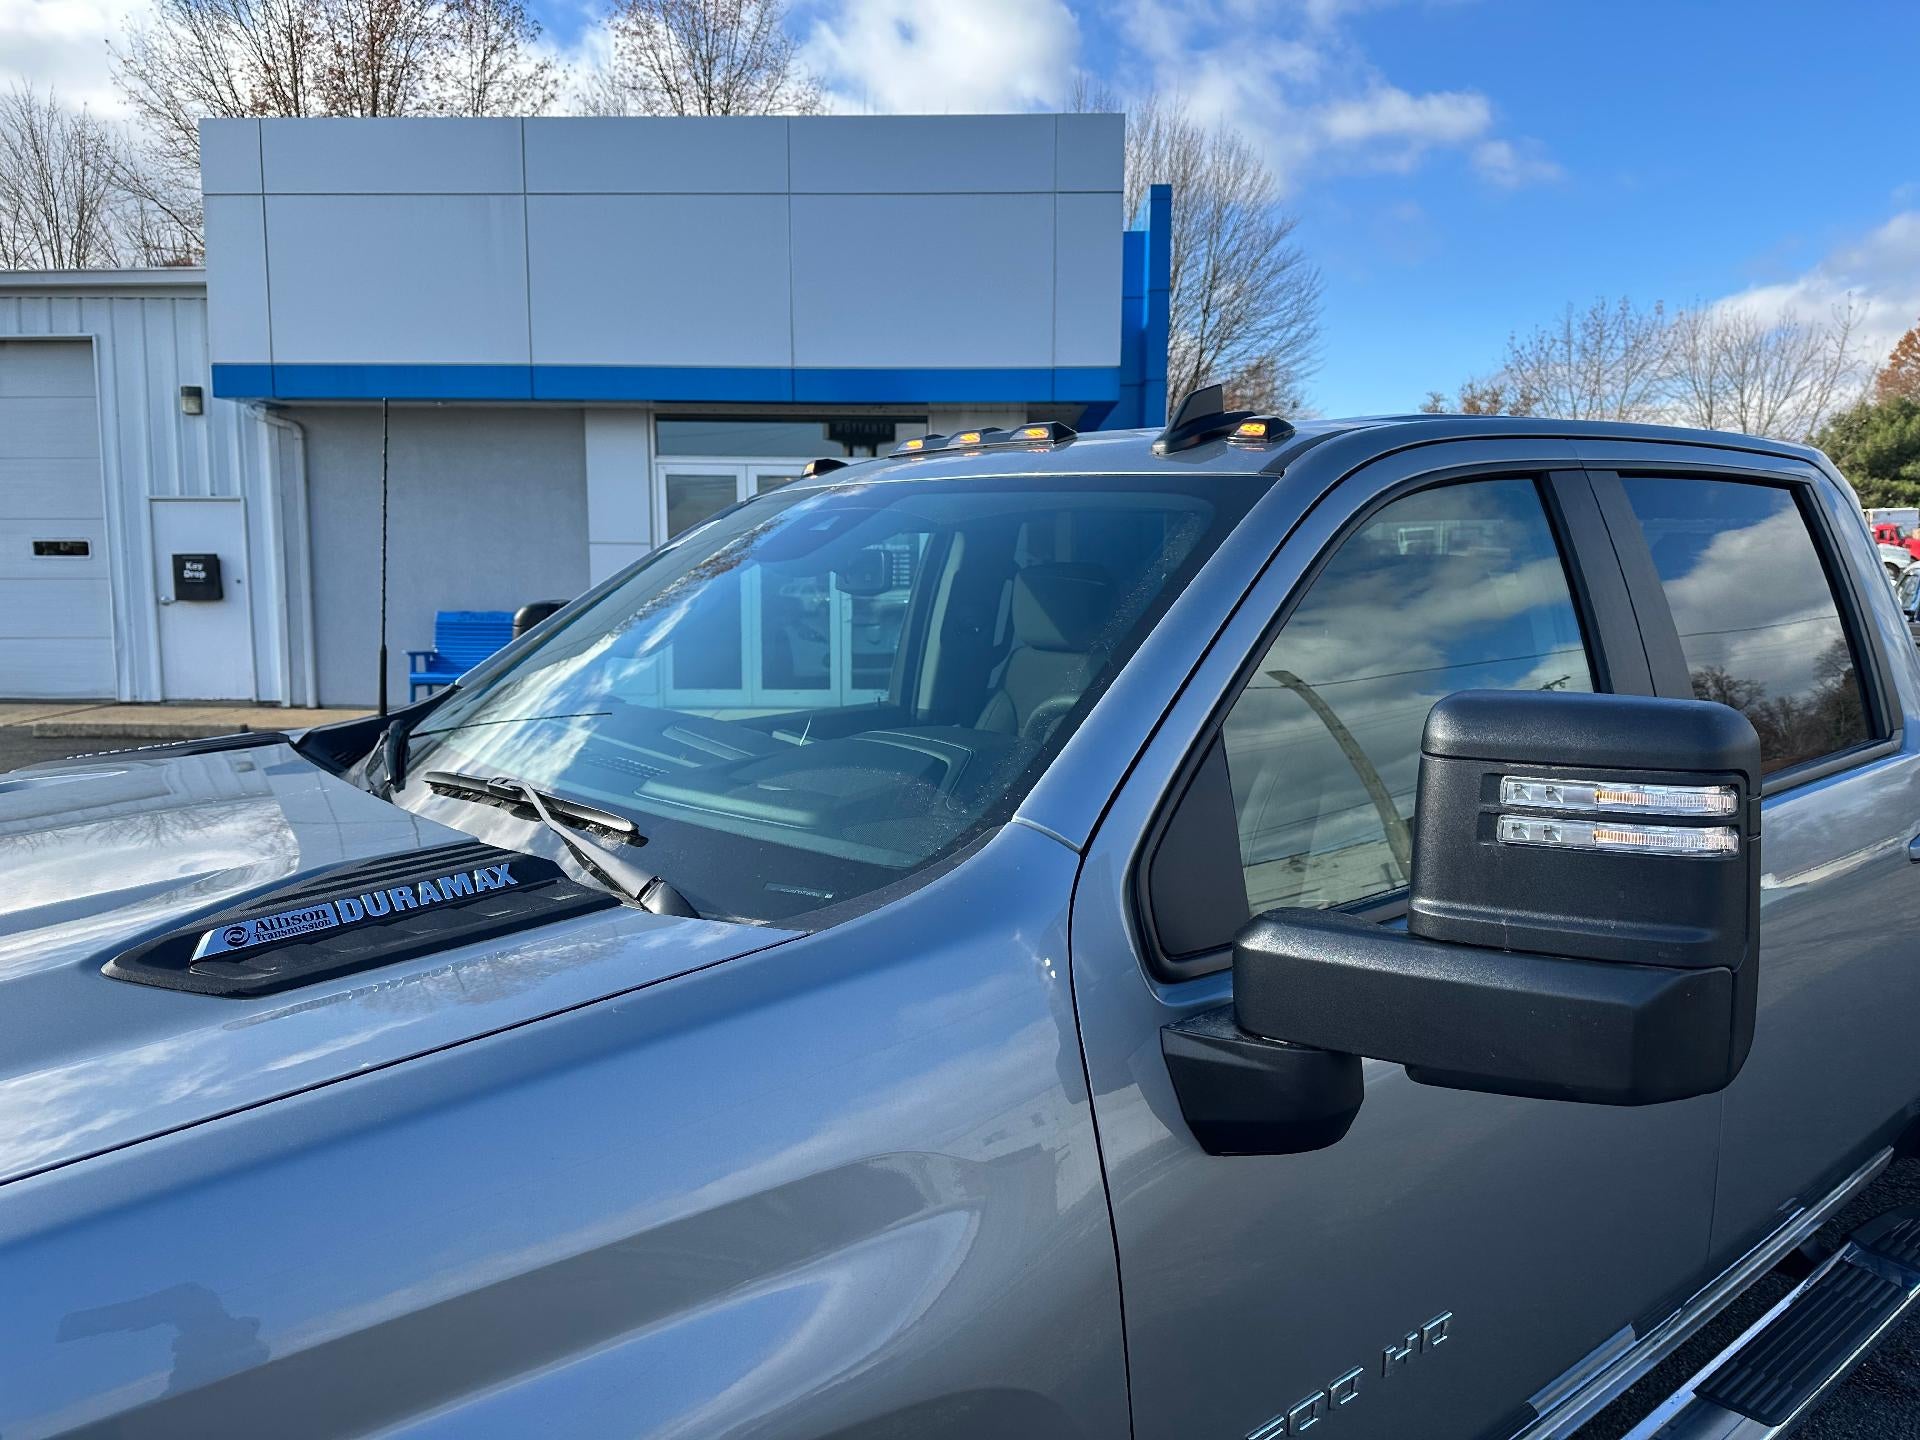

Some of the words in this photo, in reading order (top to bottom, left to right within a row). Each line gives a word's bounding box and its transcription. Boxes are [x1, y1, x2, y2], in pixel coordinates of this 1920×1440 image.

[184, 570, 207, 580] Drop
[185, 561, 204, 571] Key
[335, 863, 519, 924] DURAMAX
[254, 908, 329, 934] Allison
[254, 919, 332, 941] Transmission
[1381, 1310, 1453, 1378] HD
